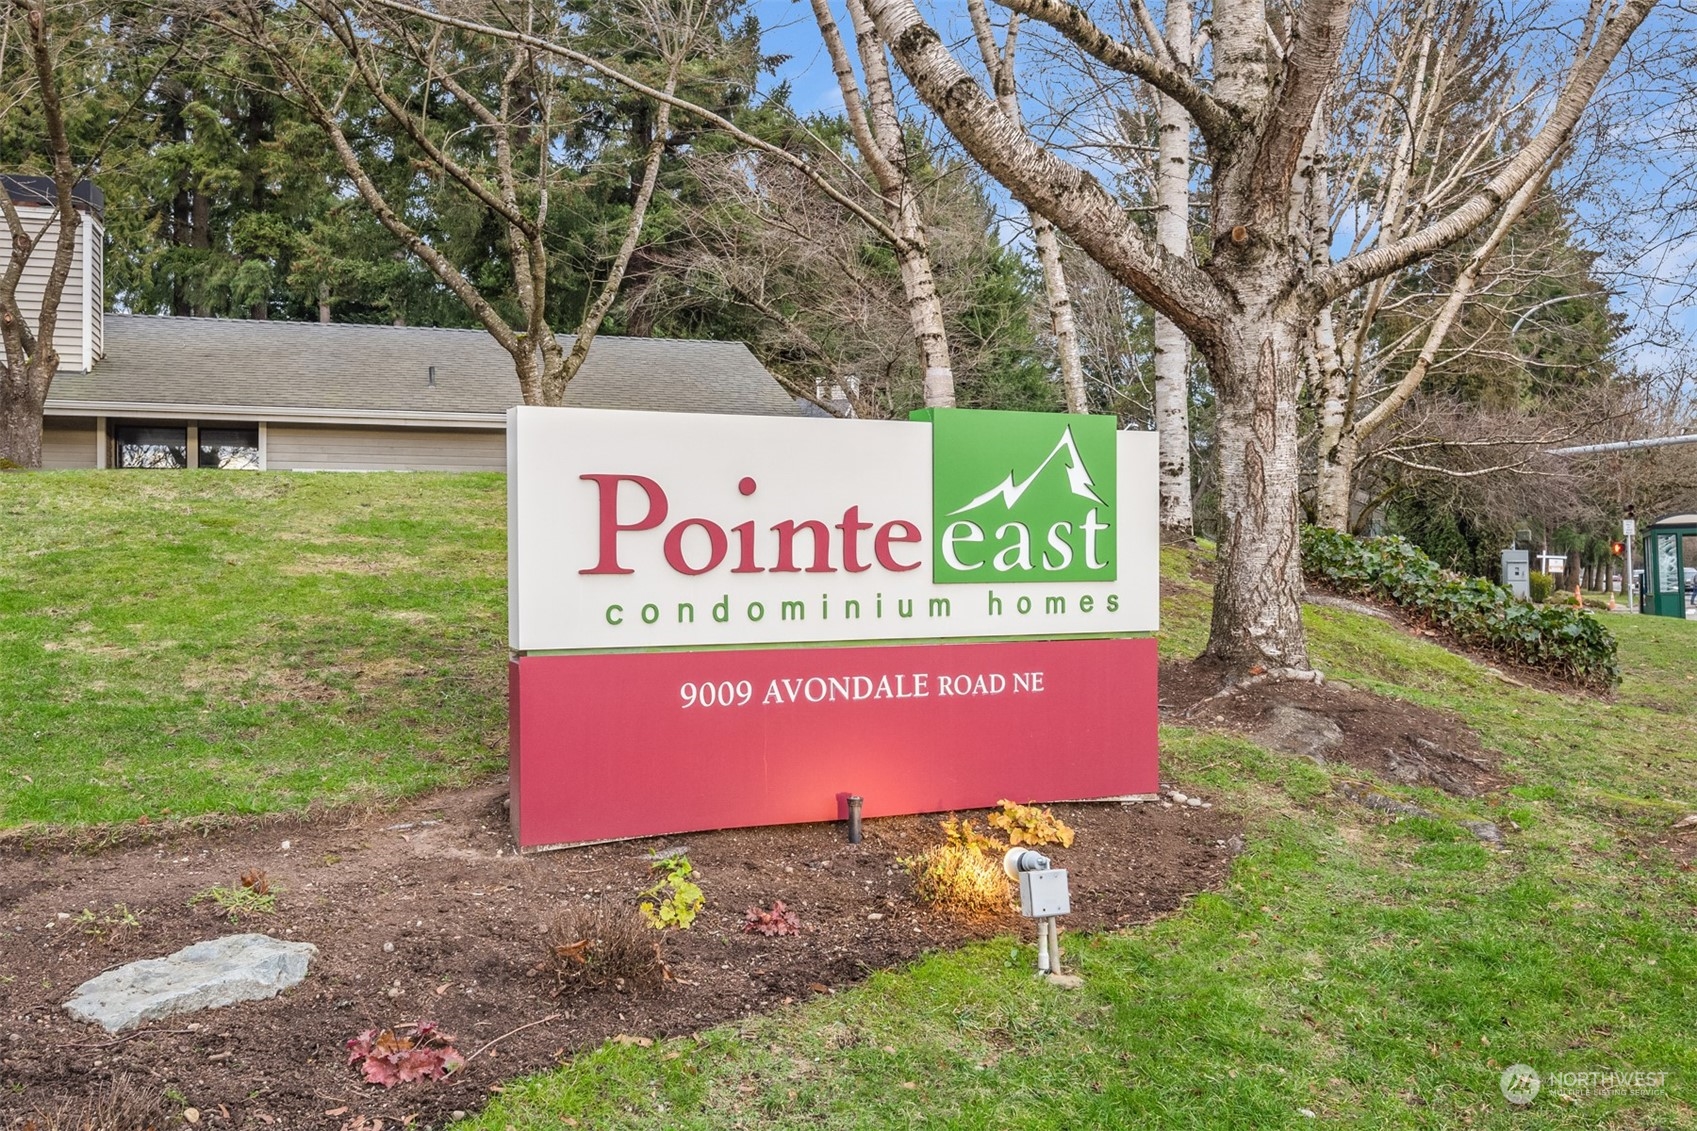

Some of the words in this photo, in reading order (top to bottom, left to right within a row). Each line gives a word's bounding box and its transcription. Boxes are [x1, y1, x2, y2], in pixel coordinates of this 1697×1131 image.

[578, 473, 922, 575] Pointe
[942, 507, 1111, 572] east
[605, 593, 951, 625] condominium
[988, 590, 1120, 616] homes
[680, 680, 753, 709] 9009
[762, 673, 930, 706] AVONDALE
[937, 674, 1005, 697] ROAD
[1012, 671, 1045, 693] NE
